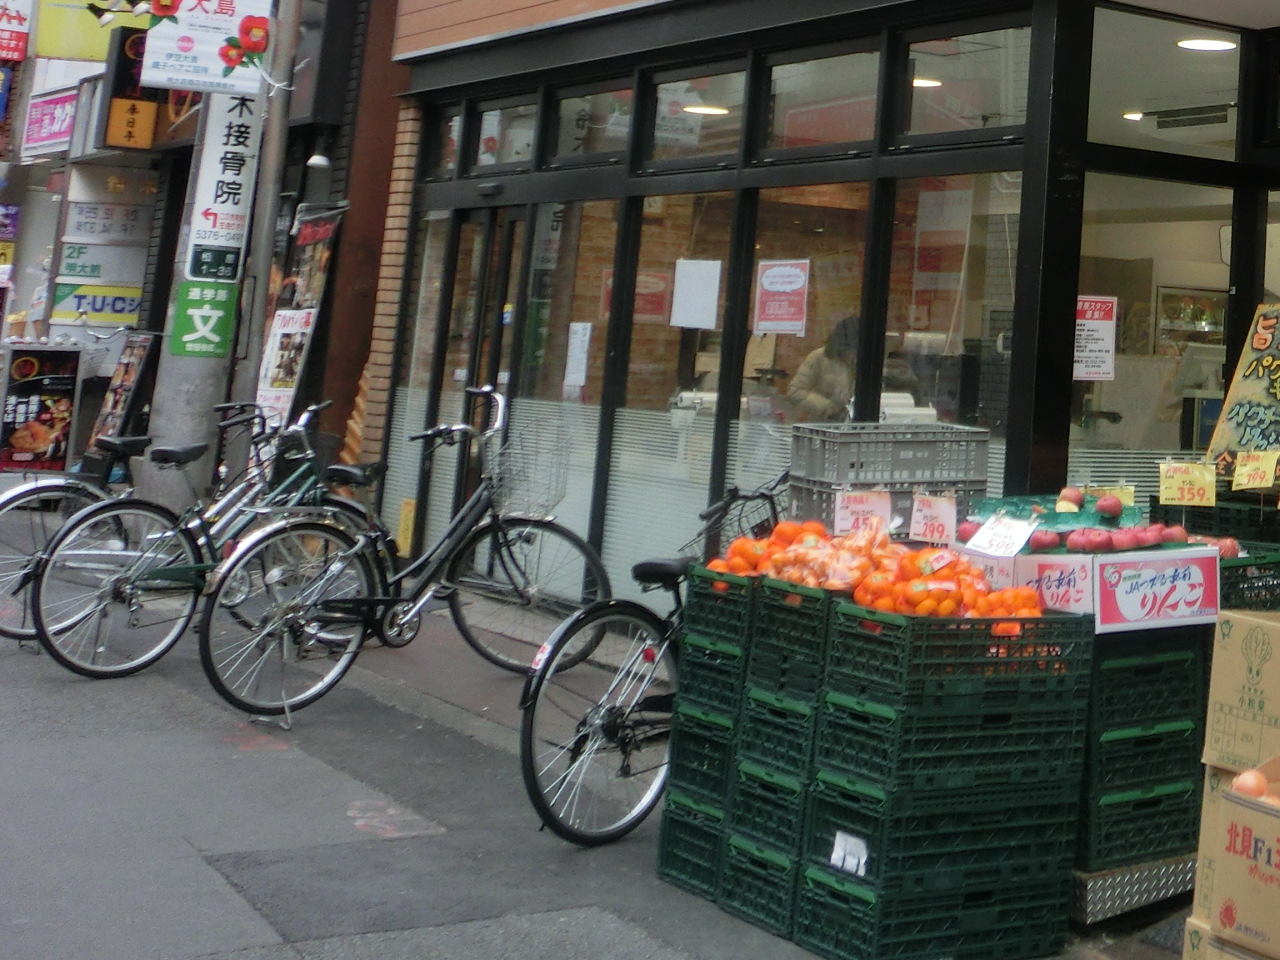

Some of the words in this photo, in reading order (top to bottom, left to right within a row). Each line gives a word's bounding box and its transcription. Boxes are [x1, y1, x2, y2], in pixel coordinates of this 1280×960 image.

[65, 246, 88, 259] 2F
[182, 304, 224, 343] 文
[1177, 487, 1206, 502] 359
[922, 522, 946, 538] 299
[1141, 583, 1204, 618] りんご
